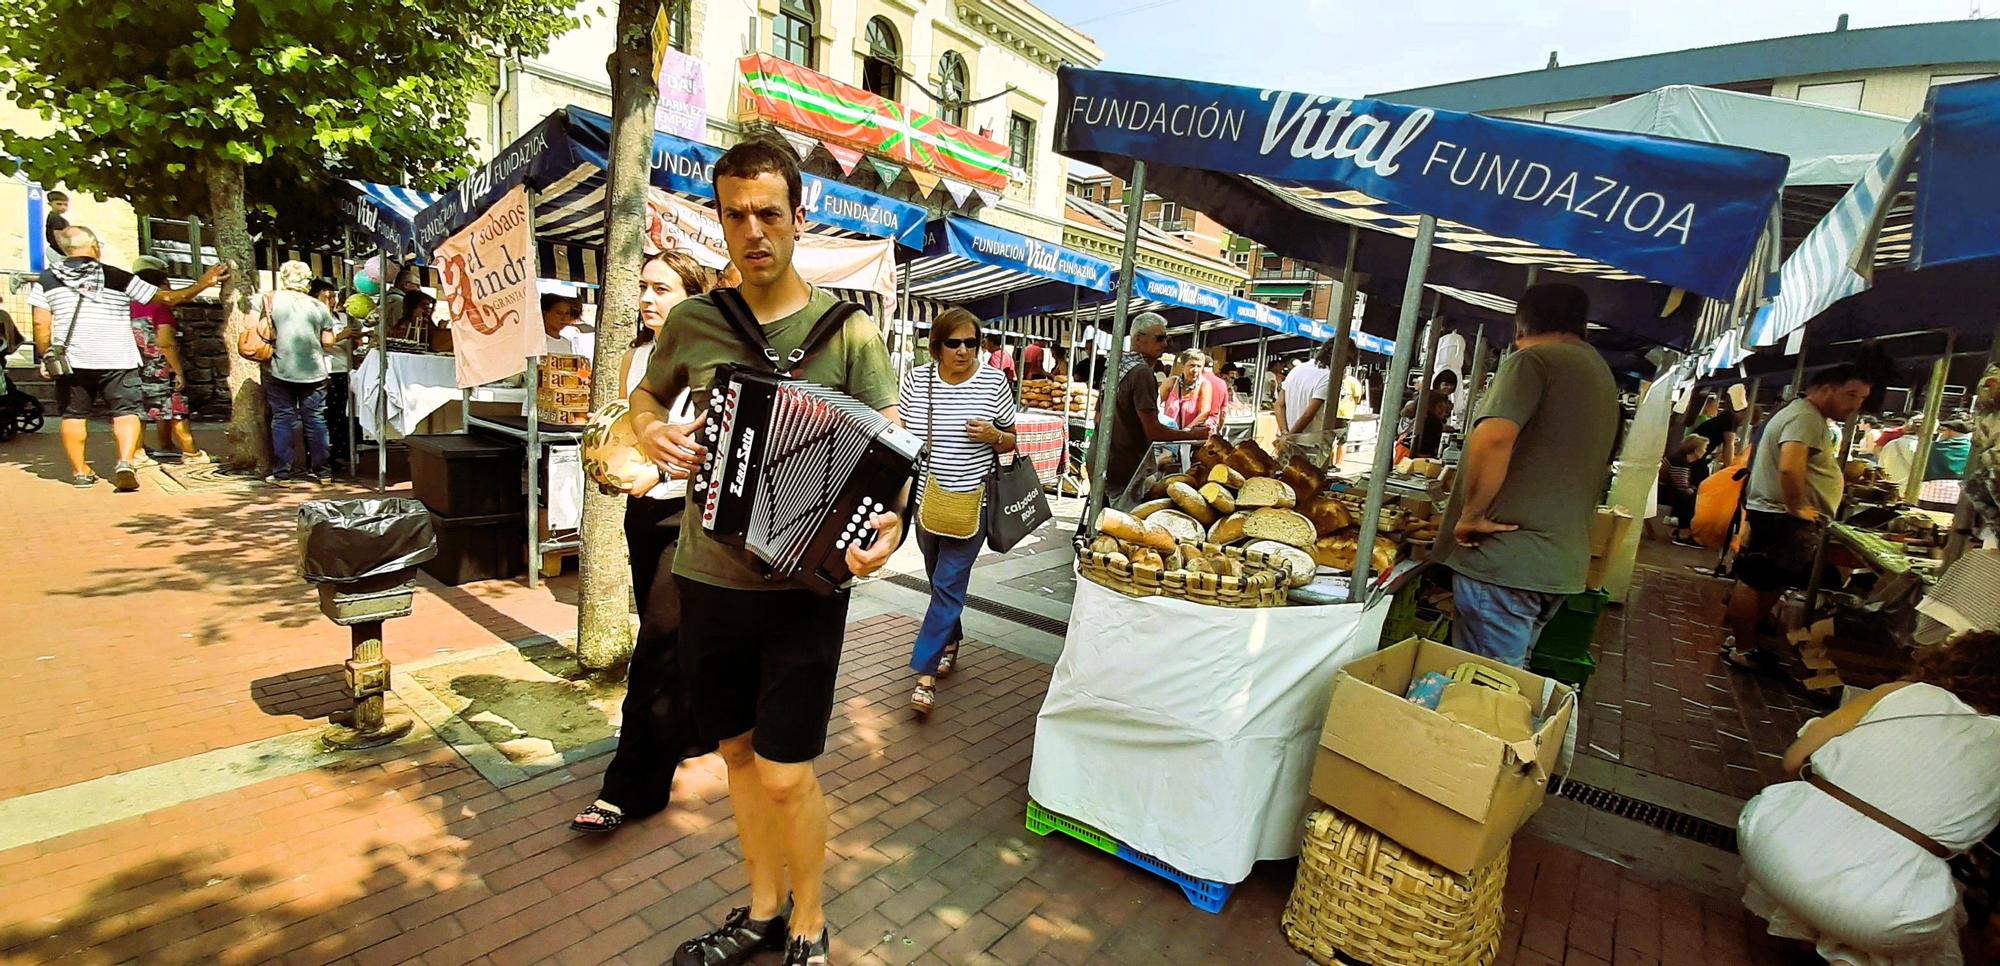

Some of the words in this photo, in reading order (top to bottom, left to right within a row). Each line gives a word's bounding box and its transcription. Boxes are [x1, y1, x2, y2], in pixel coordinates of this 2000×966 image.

[493, 132, 549, 185] FUNDAZIOA
[650, 150, 713, 183] UNDAC
[1069, 94, 1246, 142] FUNDACIÓN
[1257, 88, 1435, 179] Vital
[1420, 139, 1698, 247] FUNDAZIOA
[478, 203, 525, 246] sobaos
[824, 195, 899, 230] FUNDAZIOA
[467, 232, 485, 274] el
[472, 244, 527, 300] andr
[1024, 238, 1059, 274] Vital
[1003, 487, 1039, 516] Calzados
